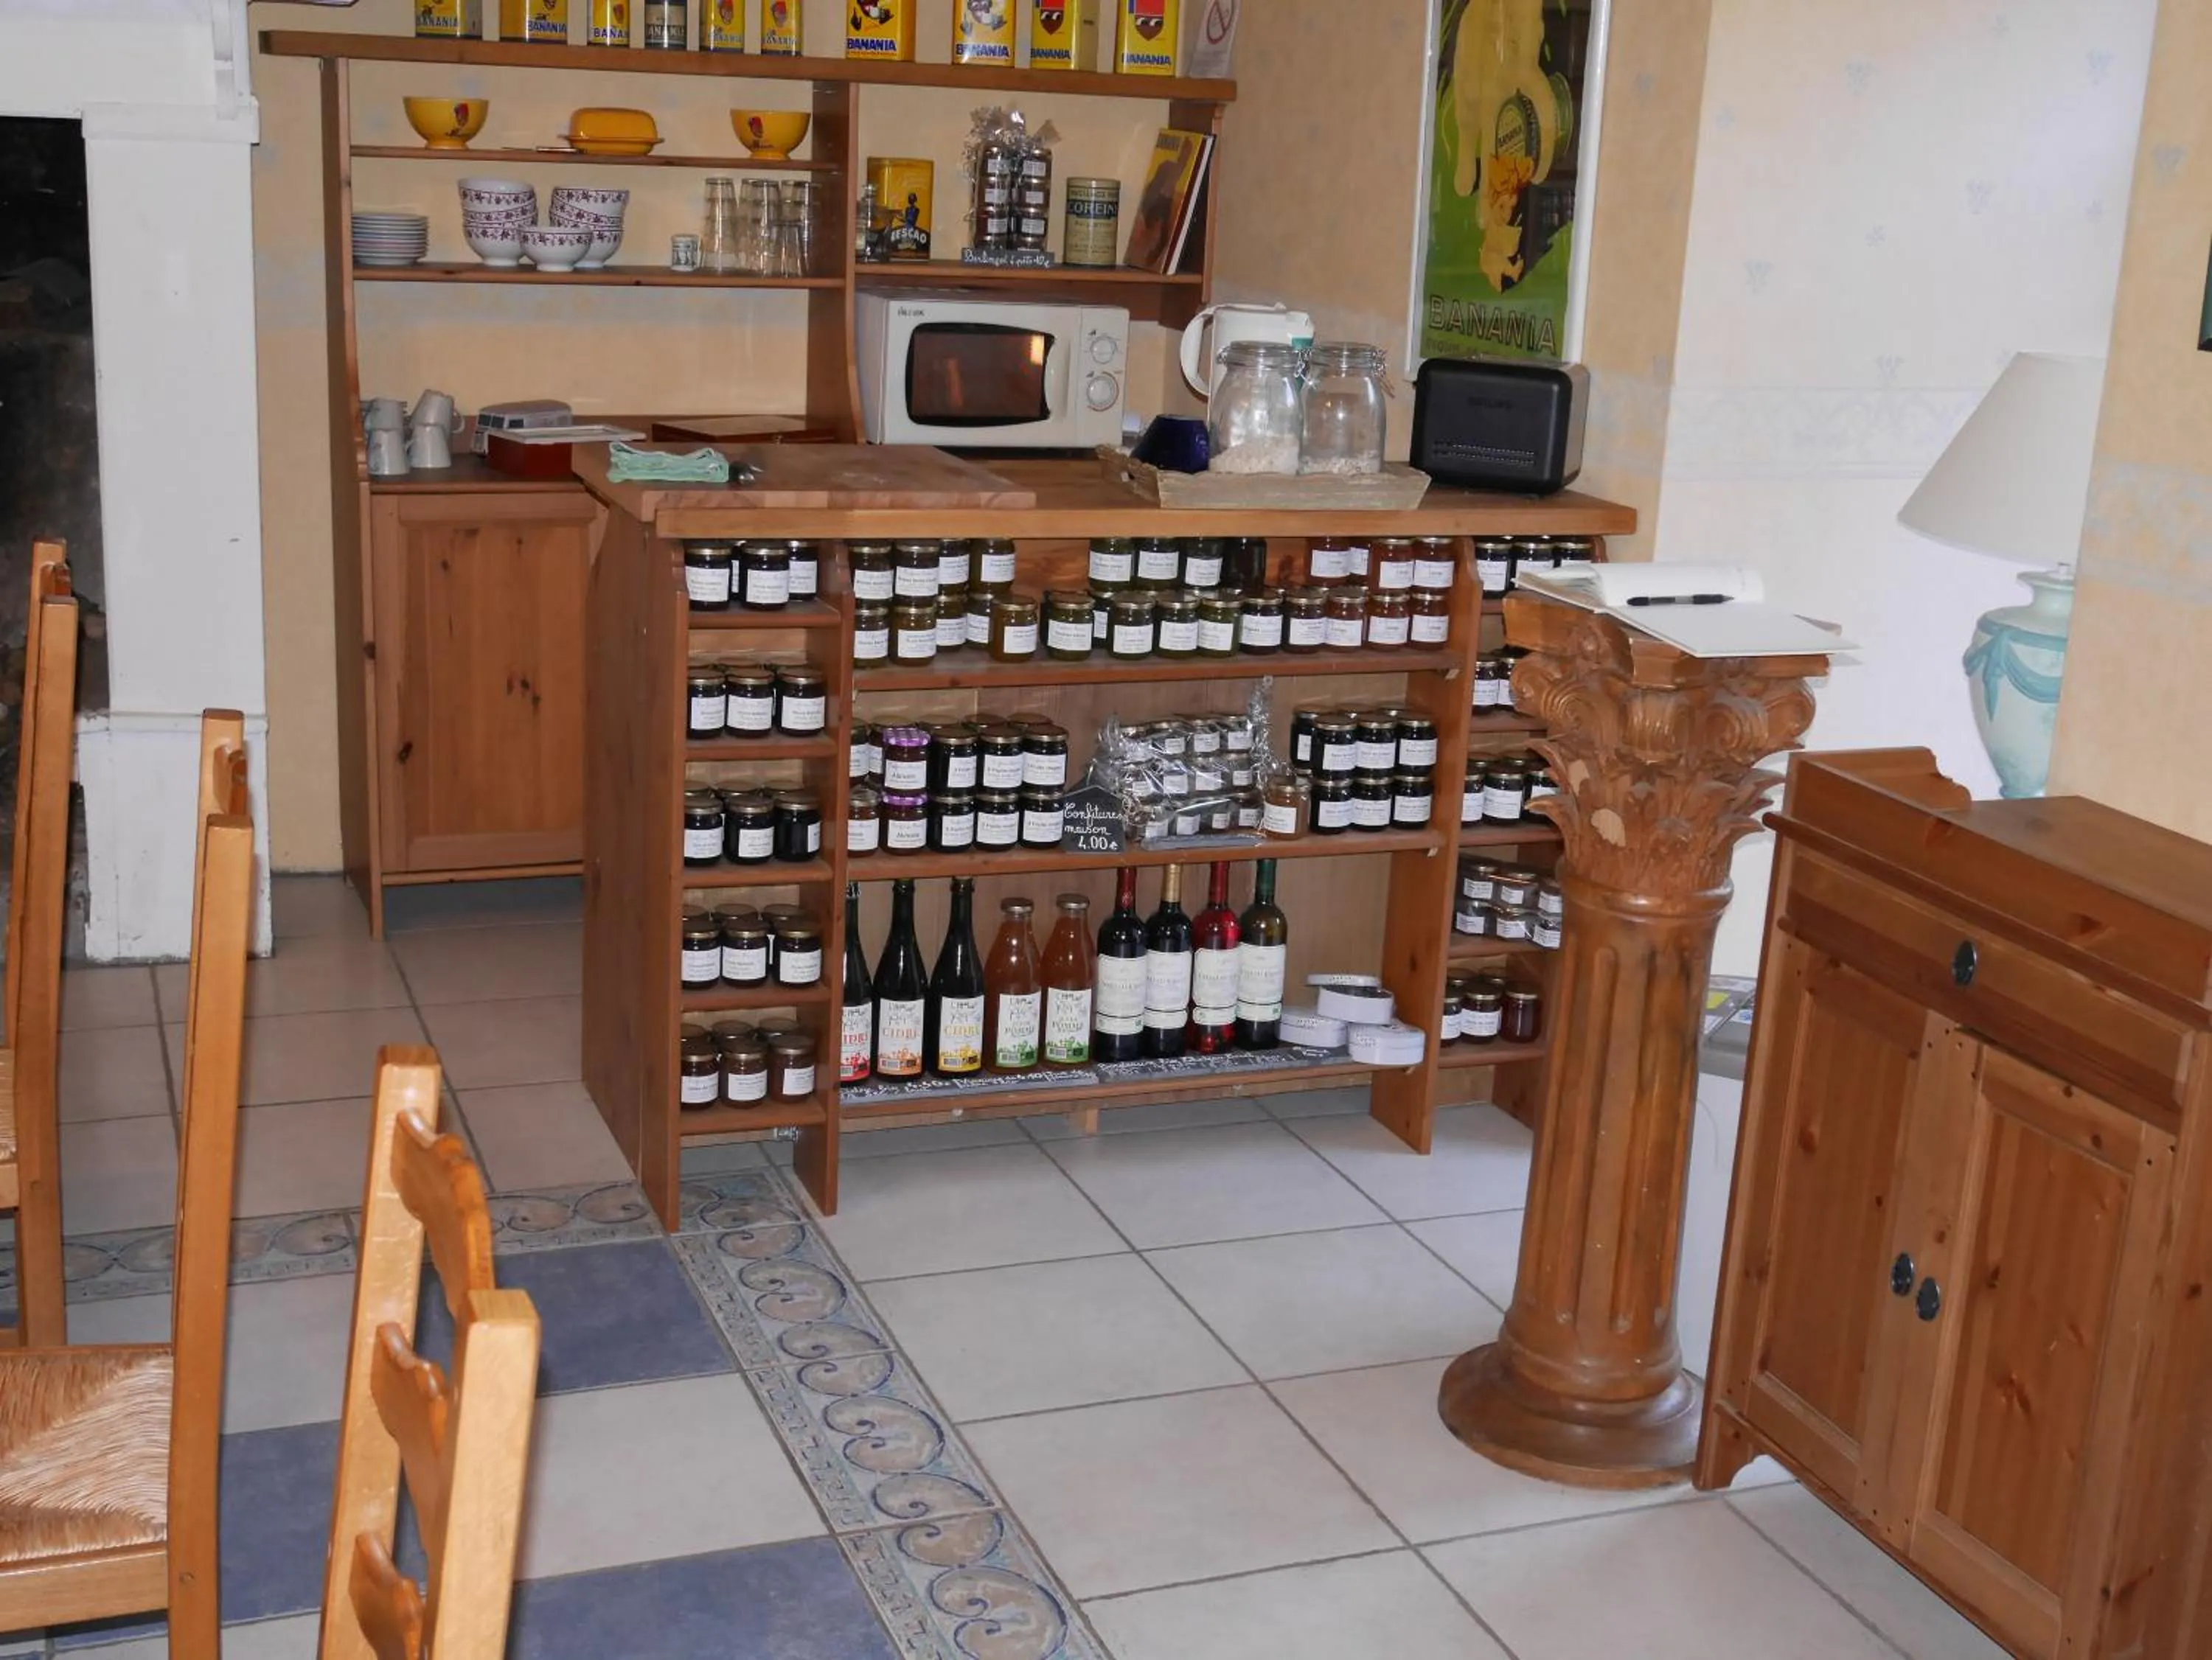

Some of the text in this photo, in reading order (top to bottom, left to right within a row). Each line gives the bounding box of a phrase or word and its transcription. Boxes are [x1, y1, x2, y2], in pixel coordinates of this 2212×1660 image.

[528, 18, 567, 33] BANANIA
[847, 37, 897, 52] BANANIA
[956, 43, 1010, 57] BANANIA
[1030, 47, 1071, 60] BANANIA
[1121, 52, 1171, 66] BANANIA
[1428, 296, 1557, 356] BANANIA
[1064, 825, 1112, 835] maison
[844, 1033, 869, 1045] IDRE
